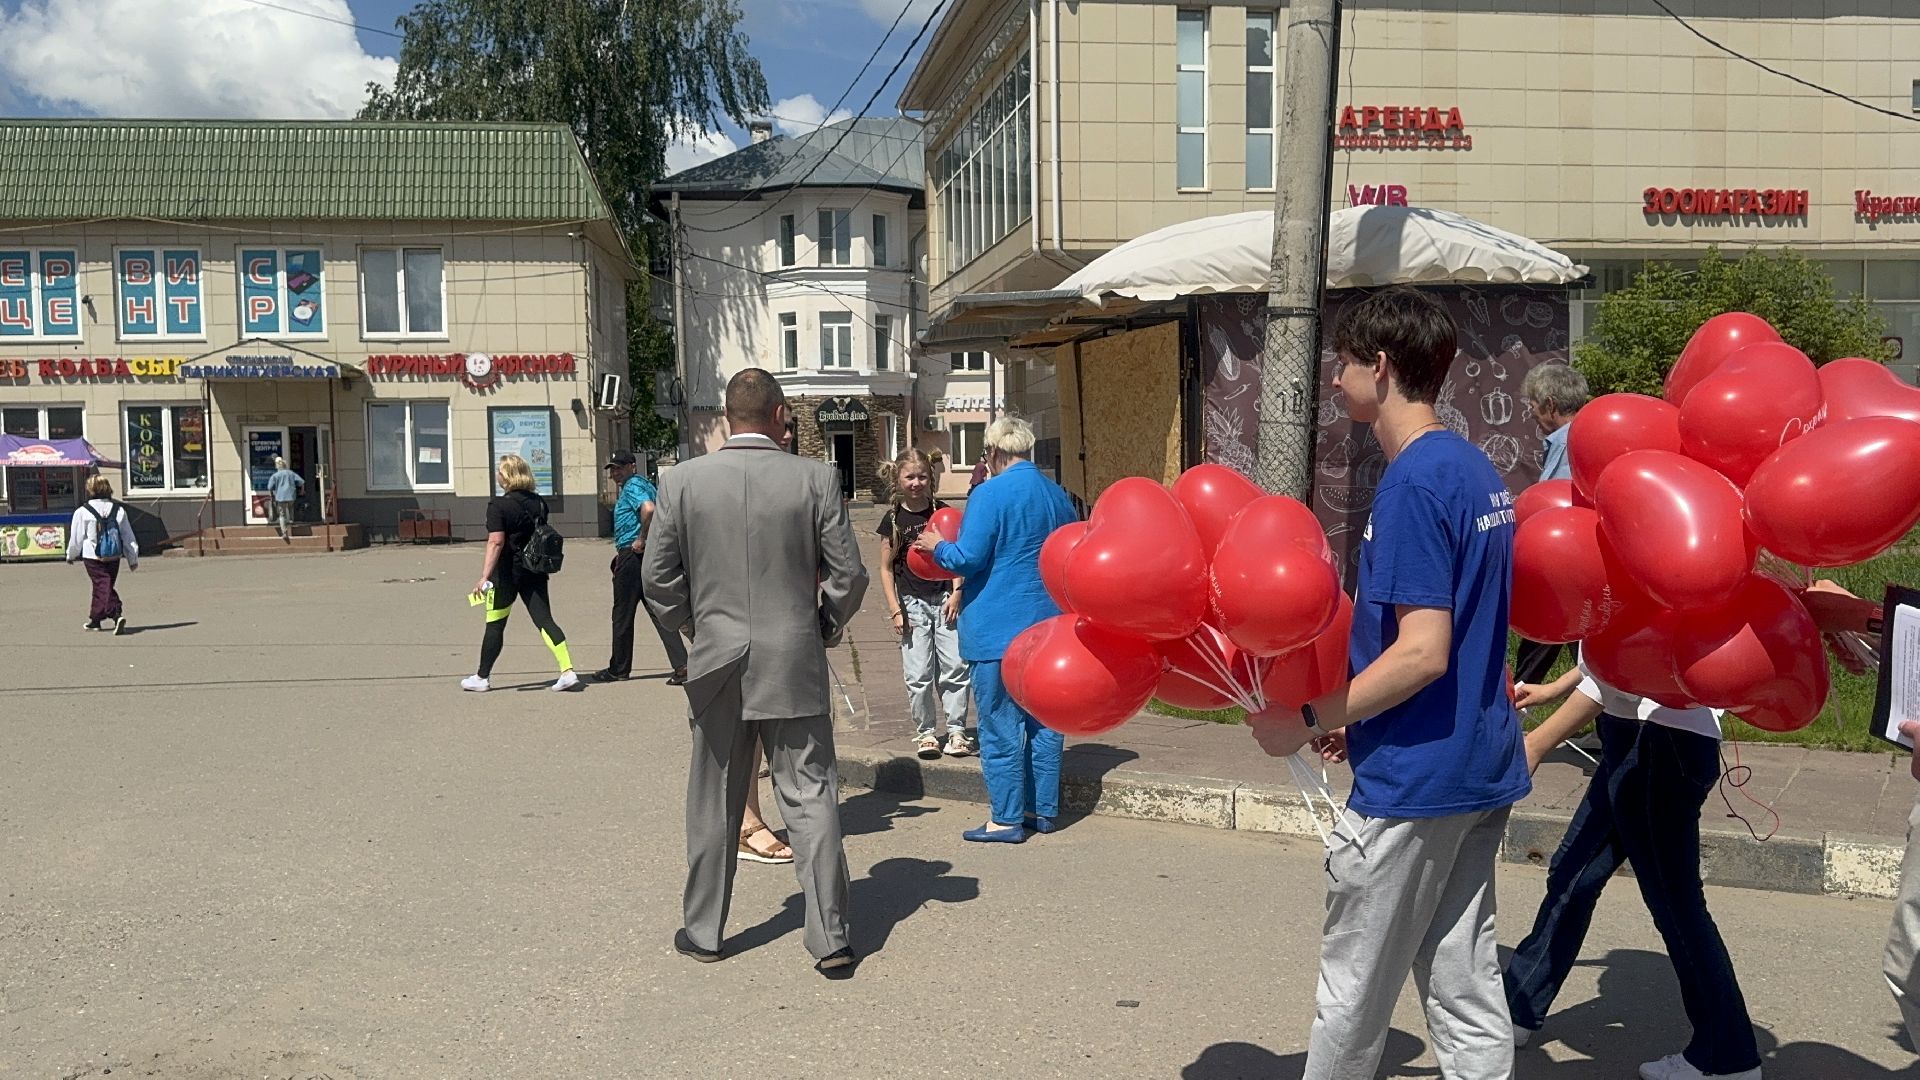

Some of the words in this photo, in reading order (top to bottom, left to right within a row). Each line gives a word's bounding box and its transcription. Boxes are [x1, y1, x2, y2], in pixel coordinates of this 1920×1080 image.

[1339, 106, 1464, 131] АРЕНДА
[1643, 187, 1809, 215] ЗООМАГАЗИН
[181, 365, 338, 378] ПАРИКМАХЕРСКАЯ
[368, 353, 465, 375] КУРИНЫЙ
[493, 353, 576, 375] МЯСНОЙ
[140, 413, 155, 473] КОФЕ
